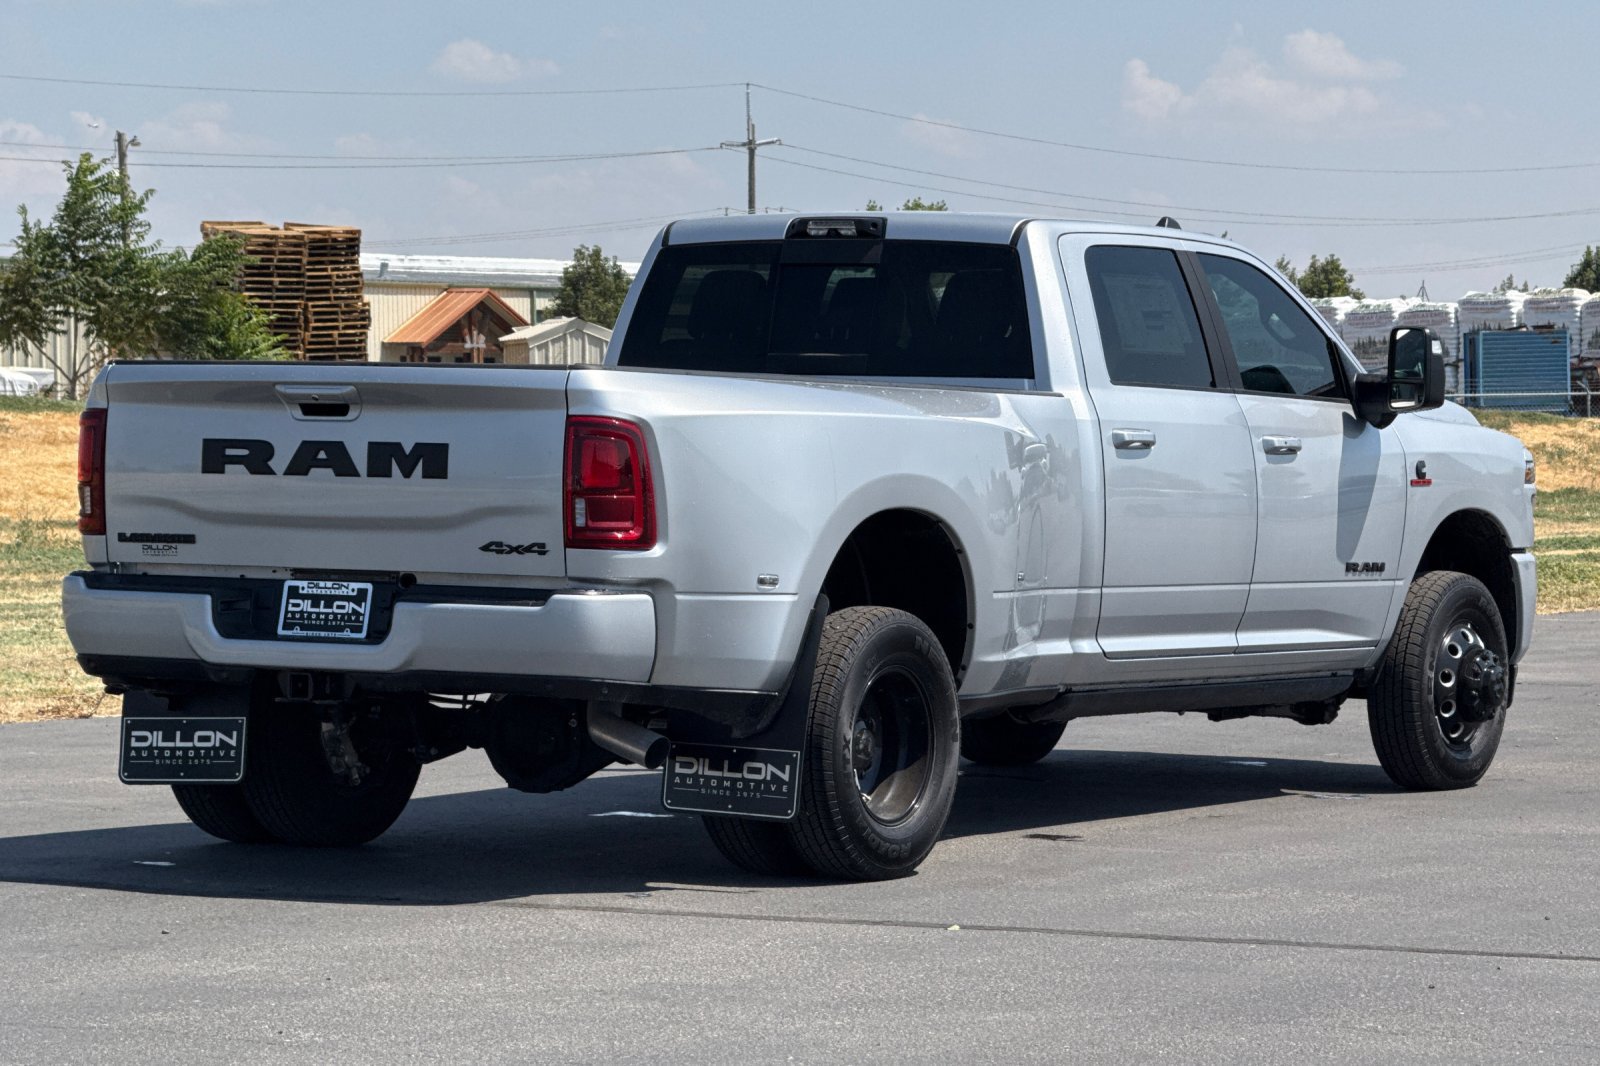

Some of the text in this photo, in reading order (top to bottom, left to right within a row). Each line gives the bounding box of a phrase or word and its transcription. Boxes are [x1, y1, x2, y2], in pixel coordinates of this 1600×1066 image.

[202, 438, 449, 479] RAM
[478, 541, 550, 556] 4x4
[1345, 562, 1386, 574] RAM
[307, 582, 349, 590] DILLON
[288, 599, 365, 614] DILLON
[287, 613, 364, 621] AUTOMOTIVE
[130, 730, 237, 747] DILLON
[675, 756, 790, 782] DILLON
[674, 776, 788, 793] AUTOMOTIVE
[700, 788, 761, 799] SINCE 1975
